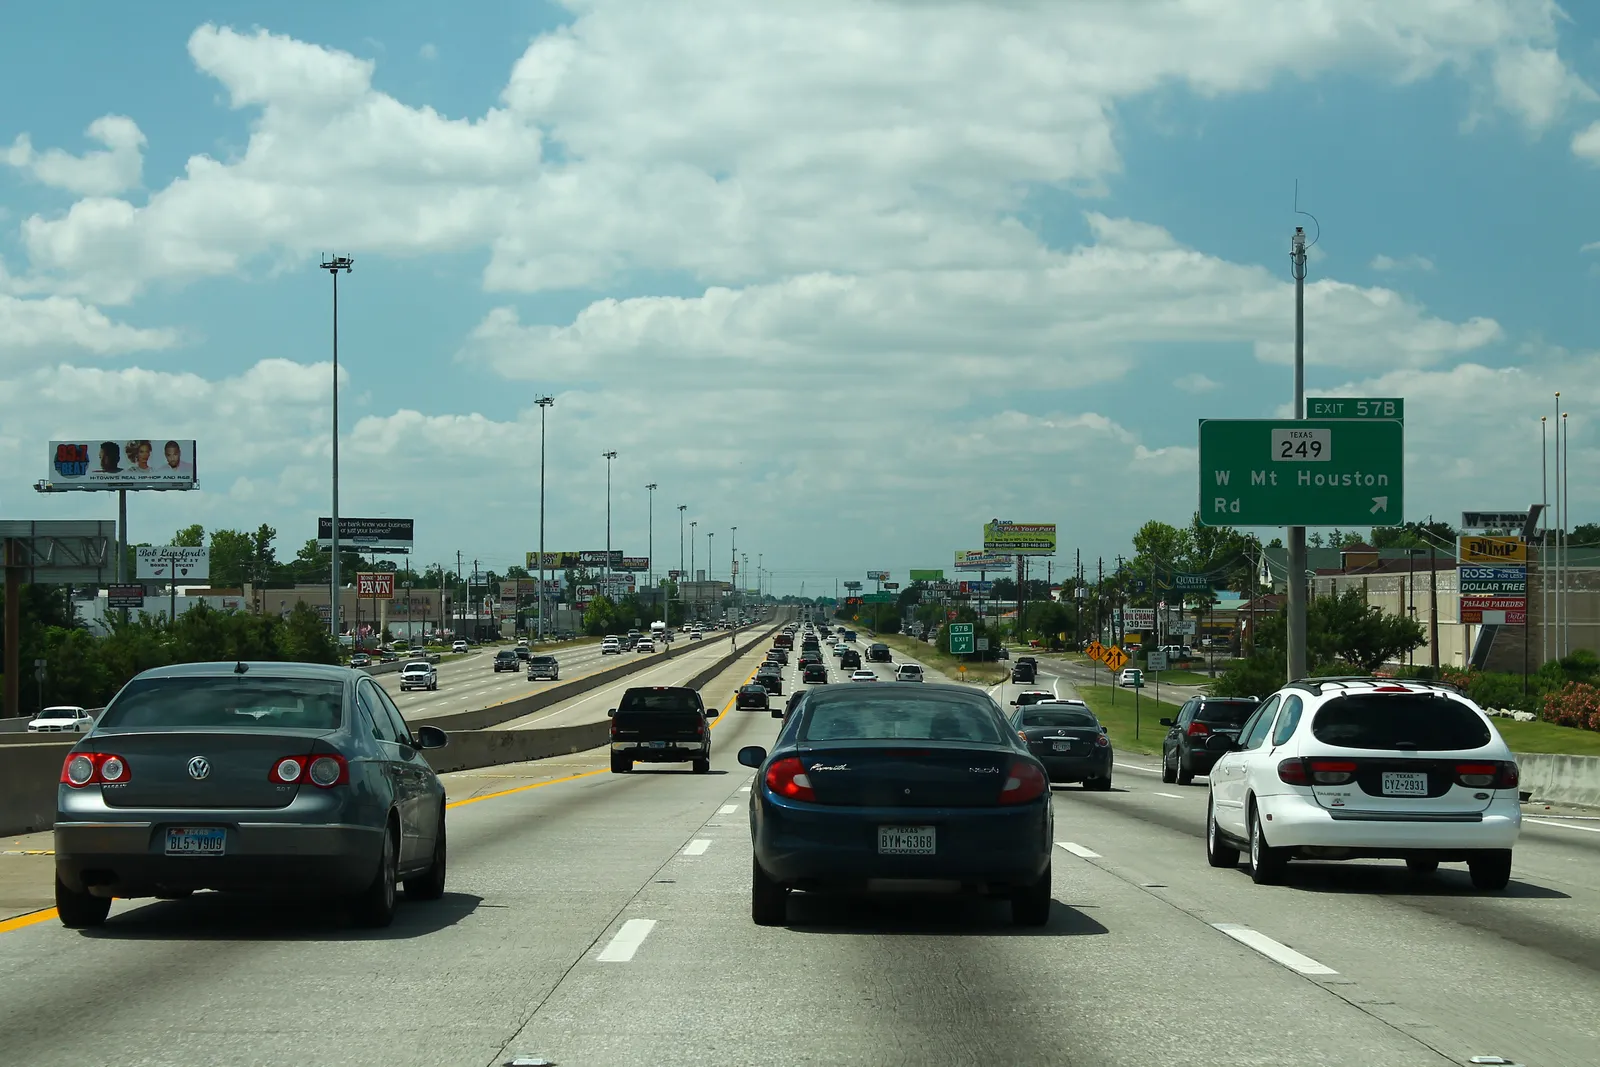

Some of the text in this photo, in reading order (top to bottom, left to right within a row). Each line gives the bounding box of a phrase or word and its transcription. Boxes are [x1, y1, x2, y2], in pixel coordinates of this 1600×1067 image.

[1315, 402, 1396, 416] EXIT 57B
[1289, 431, 1313, 439] TEXAS
[57, 444, 88, 461] 93.7
[1281, 441, 1322, 458] 249
[61, 462, 86, 475] BEAT
[1214, 470, 1389, 486] W Mt Houston
[1214, 498, 1241, 513] Rd
[138, 549, 206, 560] Bob Lunsford's
[1469, 541, 1518, 556] DUMP
[1175, 575, 1208, 585] QUALITY
[1462, 569, 1495, 579] ROSS
[360, 581, 390, 594] PAWN
[1461, 583, 1526, 591] DOLLAR TREE
[1385, 780, 1425, 791] CYZ 2931
[171, 836, 190, 850] BL5
[907, 835, 932, 848] 6368
